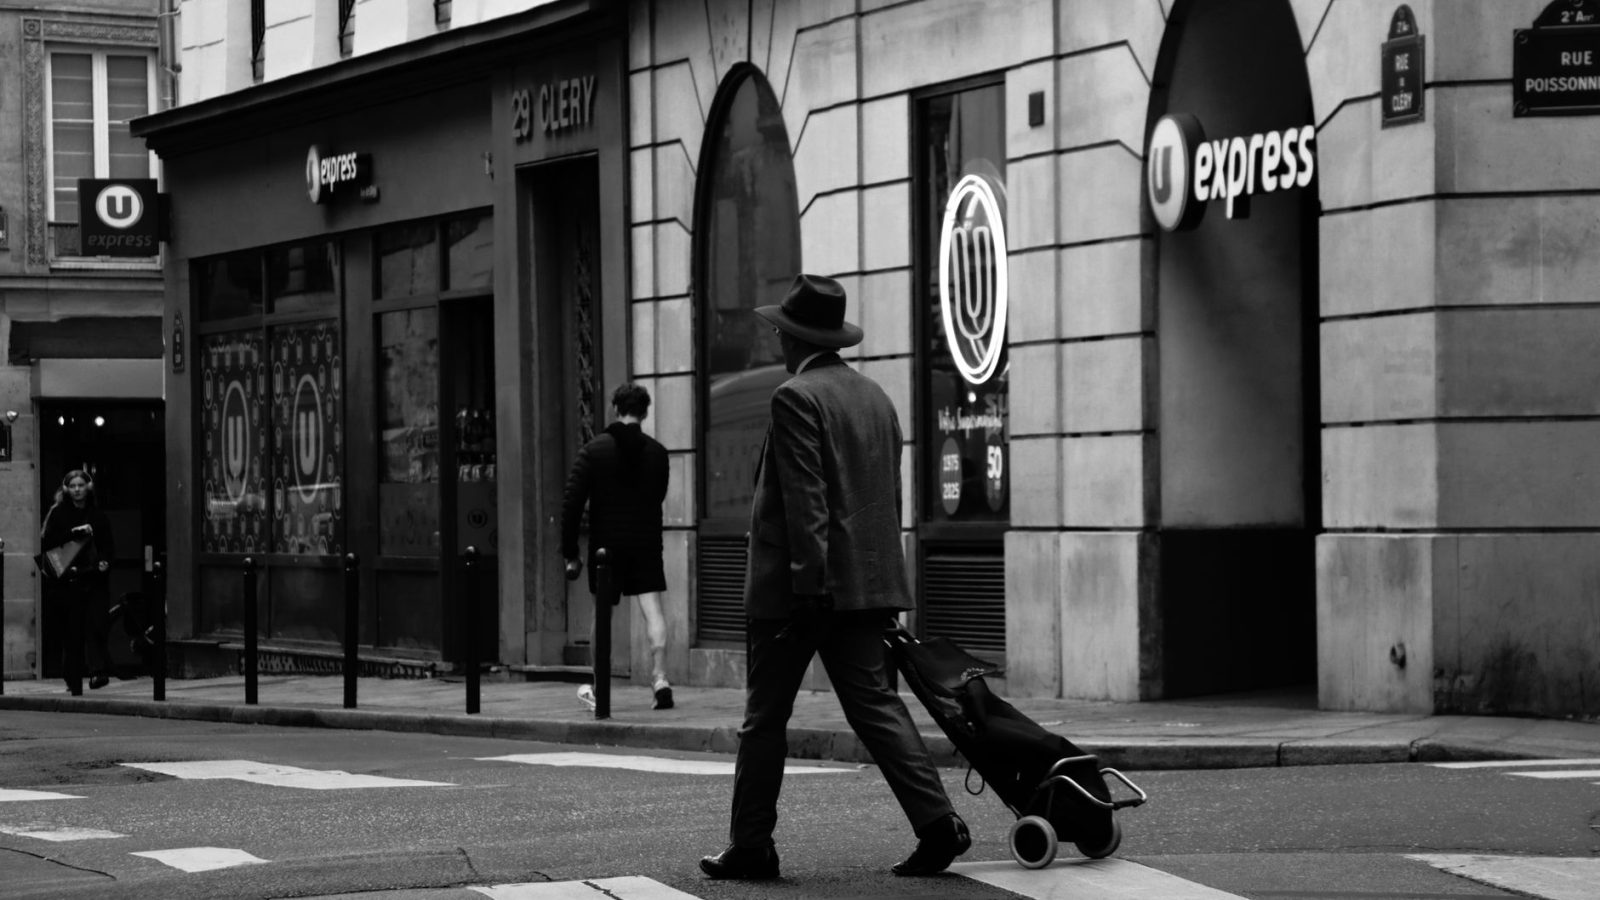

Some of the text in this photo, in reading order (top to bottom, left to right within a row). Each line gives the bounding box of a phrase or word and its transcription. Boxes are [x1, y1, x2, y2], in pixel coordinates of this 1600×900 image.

[1561, 50, 1593, 66] RUE
[512, 75, 594, 138] 29 CLERY
[321, 151, 357, 193] express
[1194, 125, 1315, 219] express
[106, 195, 132, 219] U
[88, 233, 152, 249] express
[987, 445, 1003, 479] 50
